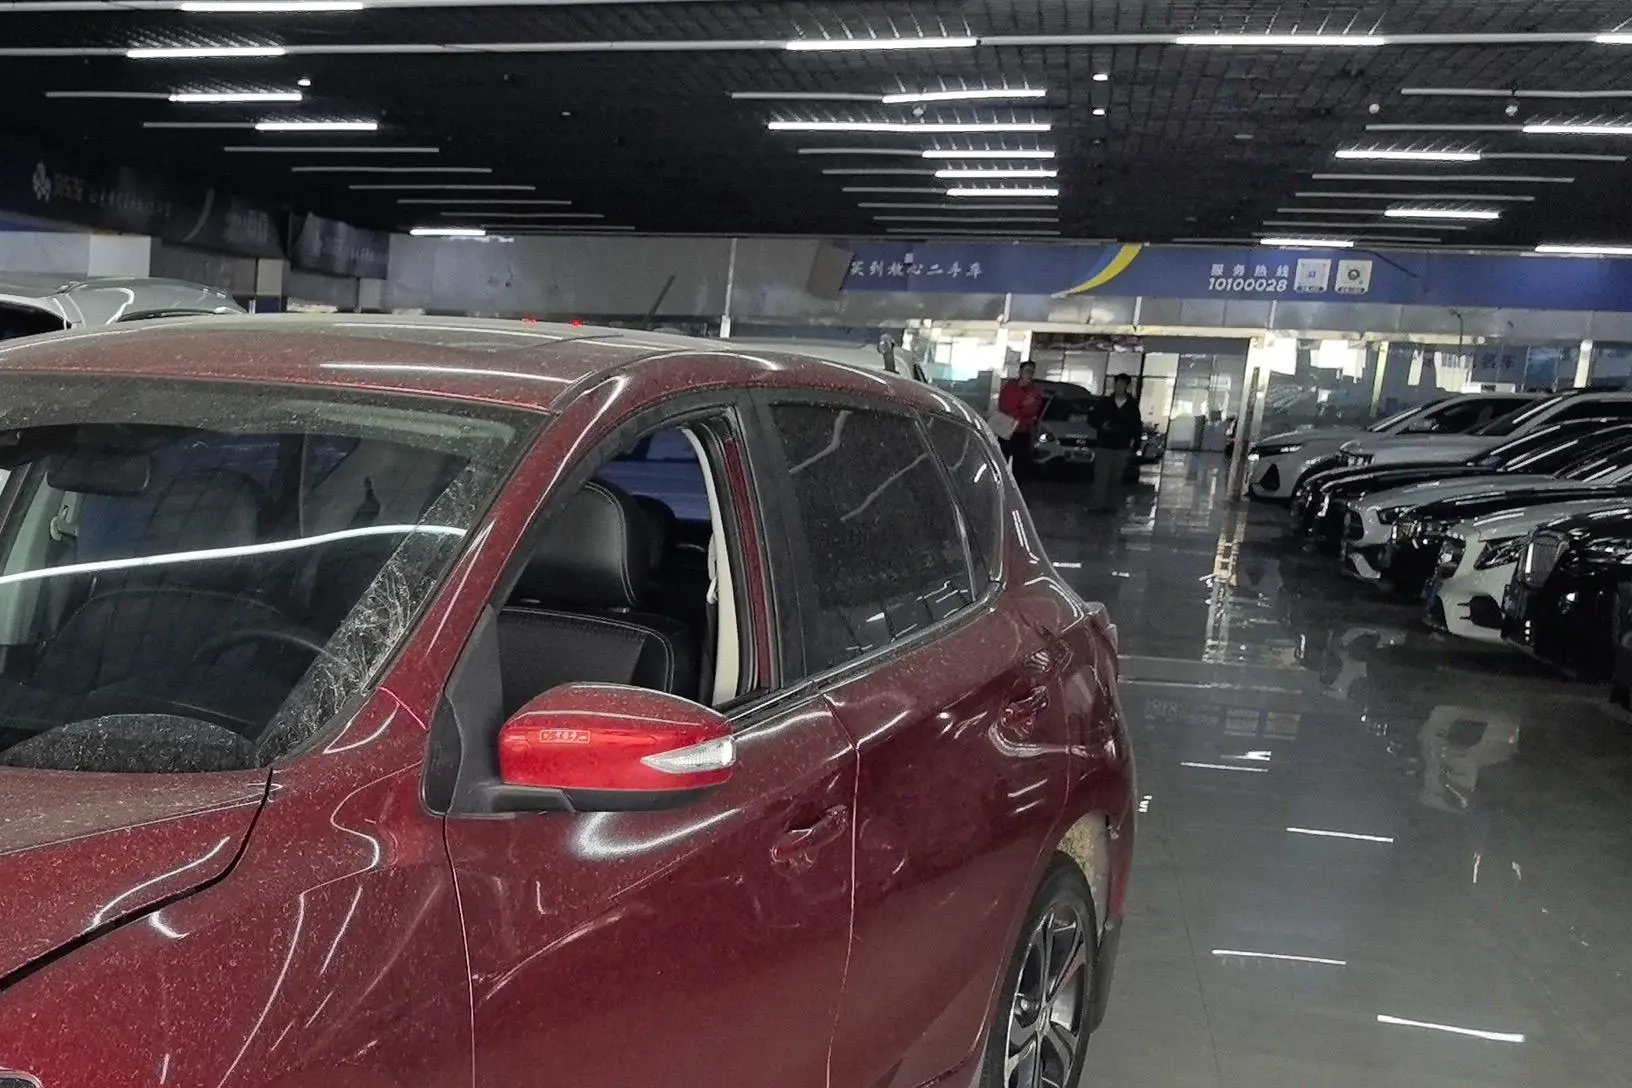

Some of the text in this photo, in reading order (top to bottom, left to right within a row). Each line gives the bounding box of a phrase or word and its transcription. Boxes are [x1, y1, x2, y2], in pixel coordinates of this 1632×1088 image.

[1210, 263, 1290, 278] 服务热线
[1208, 277, 1289, 293] 10100028
